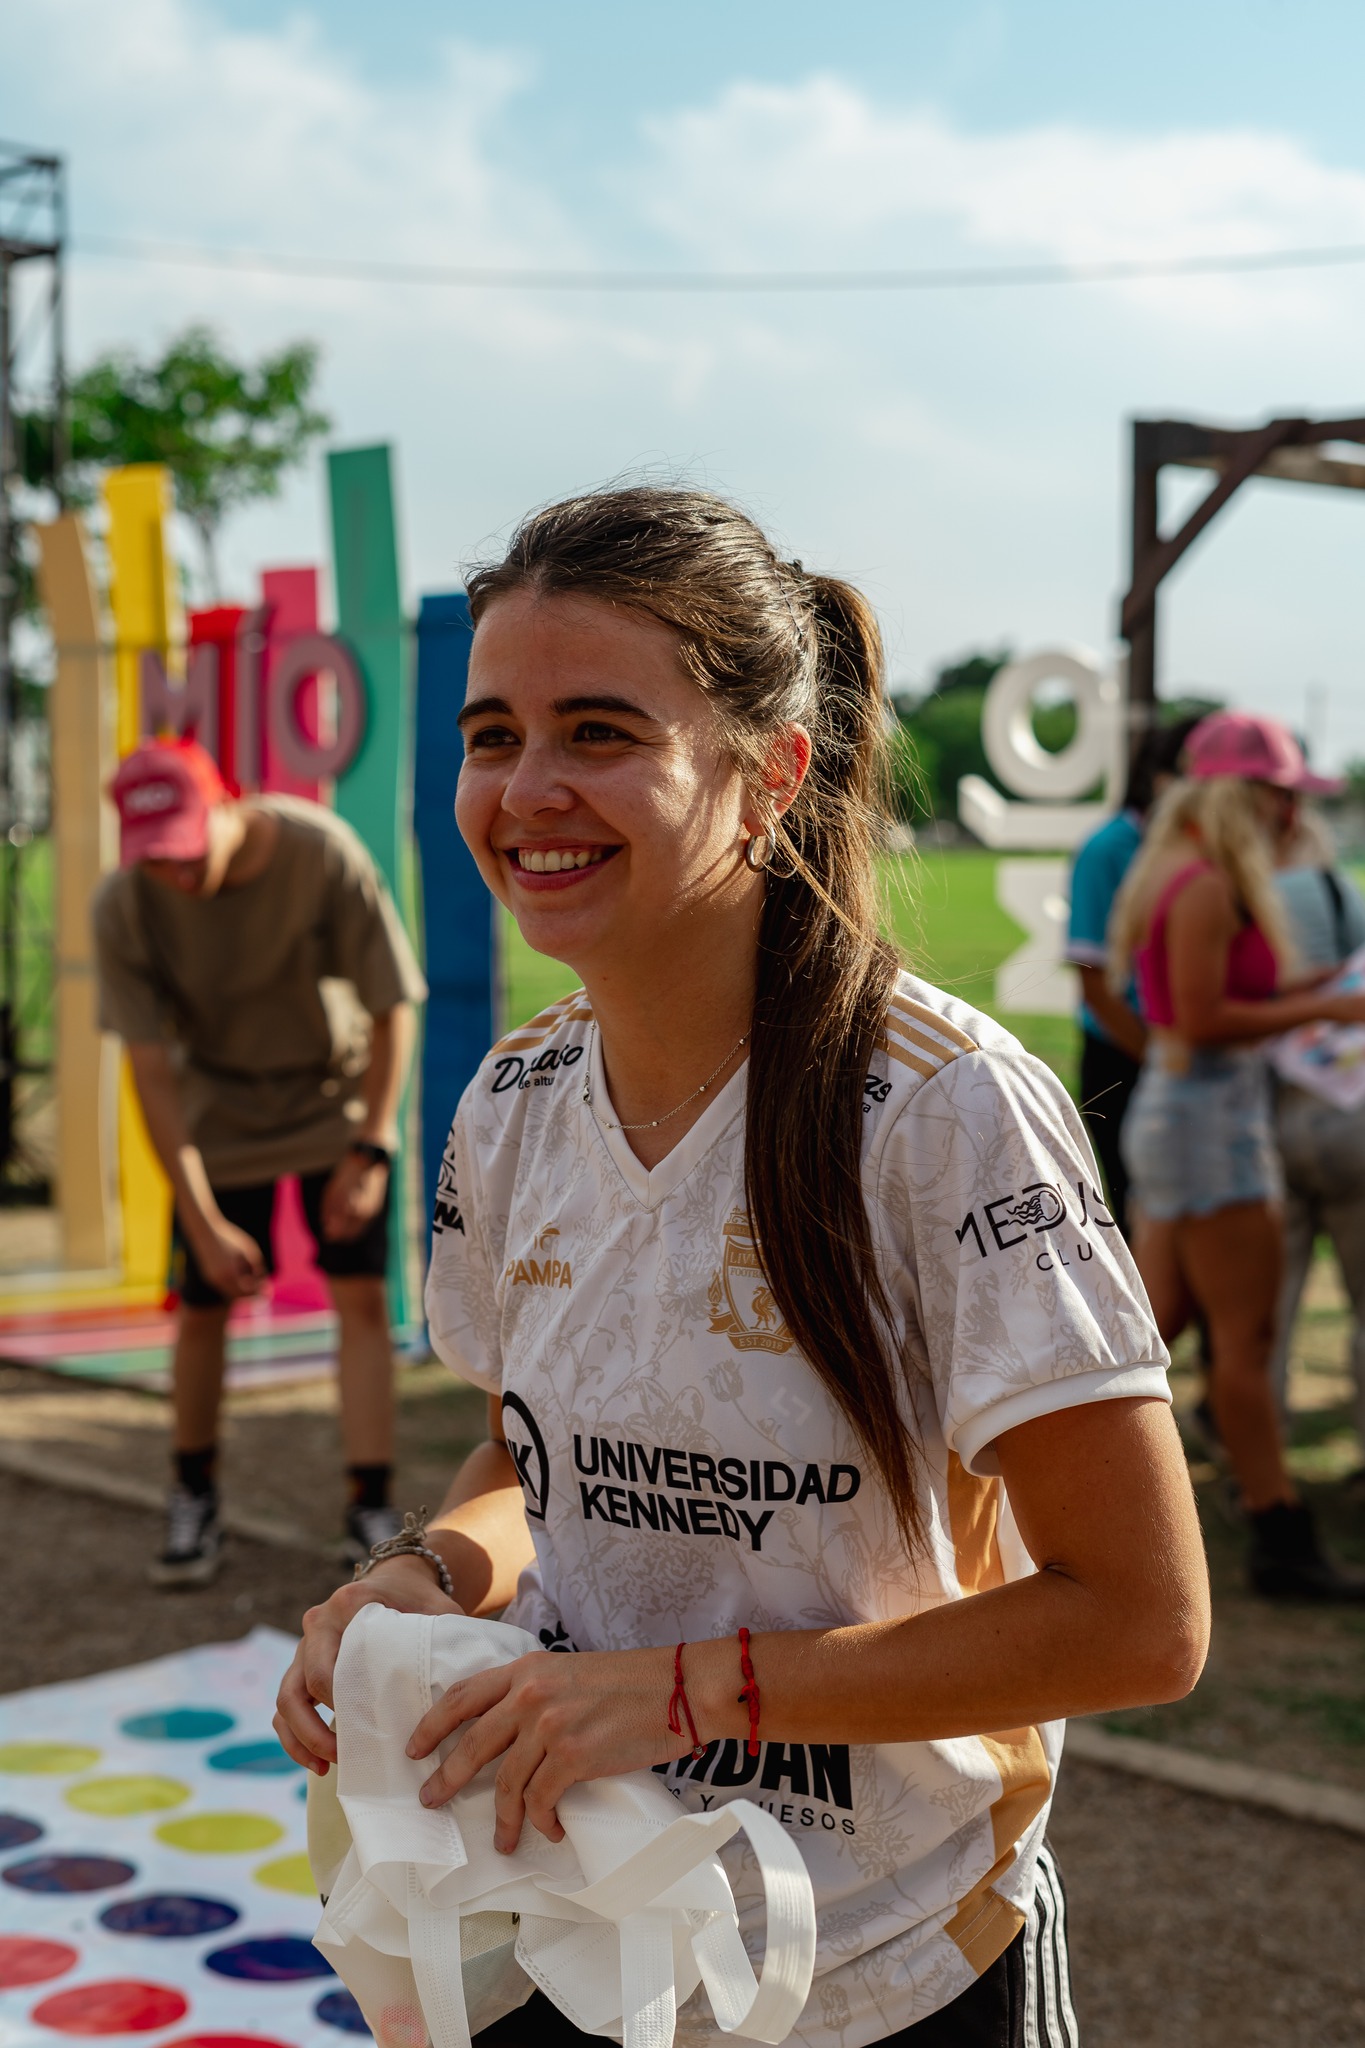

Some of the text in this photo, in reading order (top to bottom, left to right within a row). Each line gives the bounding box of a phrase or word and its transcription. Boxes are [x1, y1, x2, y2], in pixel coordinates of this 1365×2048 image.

[955, 1181, 1116, 1259] MEDUS
[730, 1251, 759, 1266] LIVE
[1036, 1242, 1094, 1271] CLU
[503, 1258, 573, 1290] PAMPA
[730, 1267, 764, 1279] FOOTB
[739, 1336, 759, 1348] EST
[573, 1433, 861, 1506] UNIVERSIDAD
[578, 1481, 775, 1551] KENNEDY
